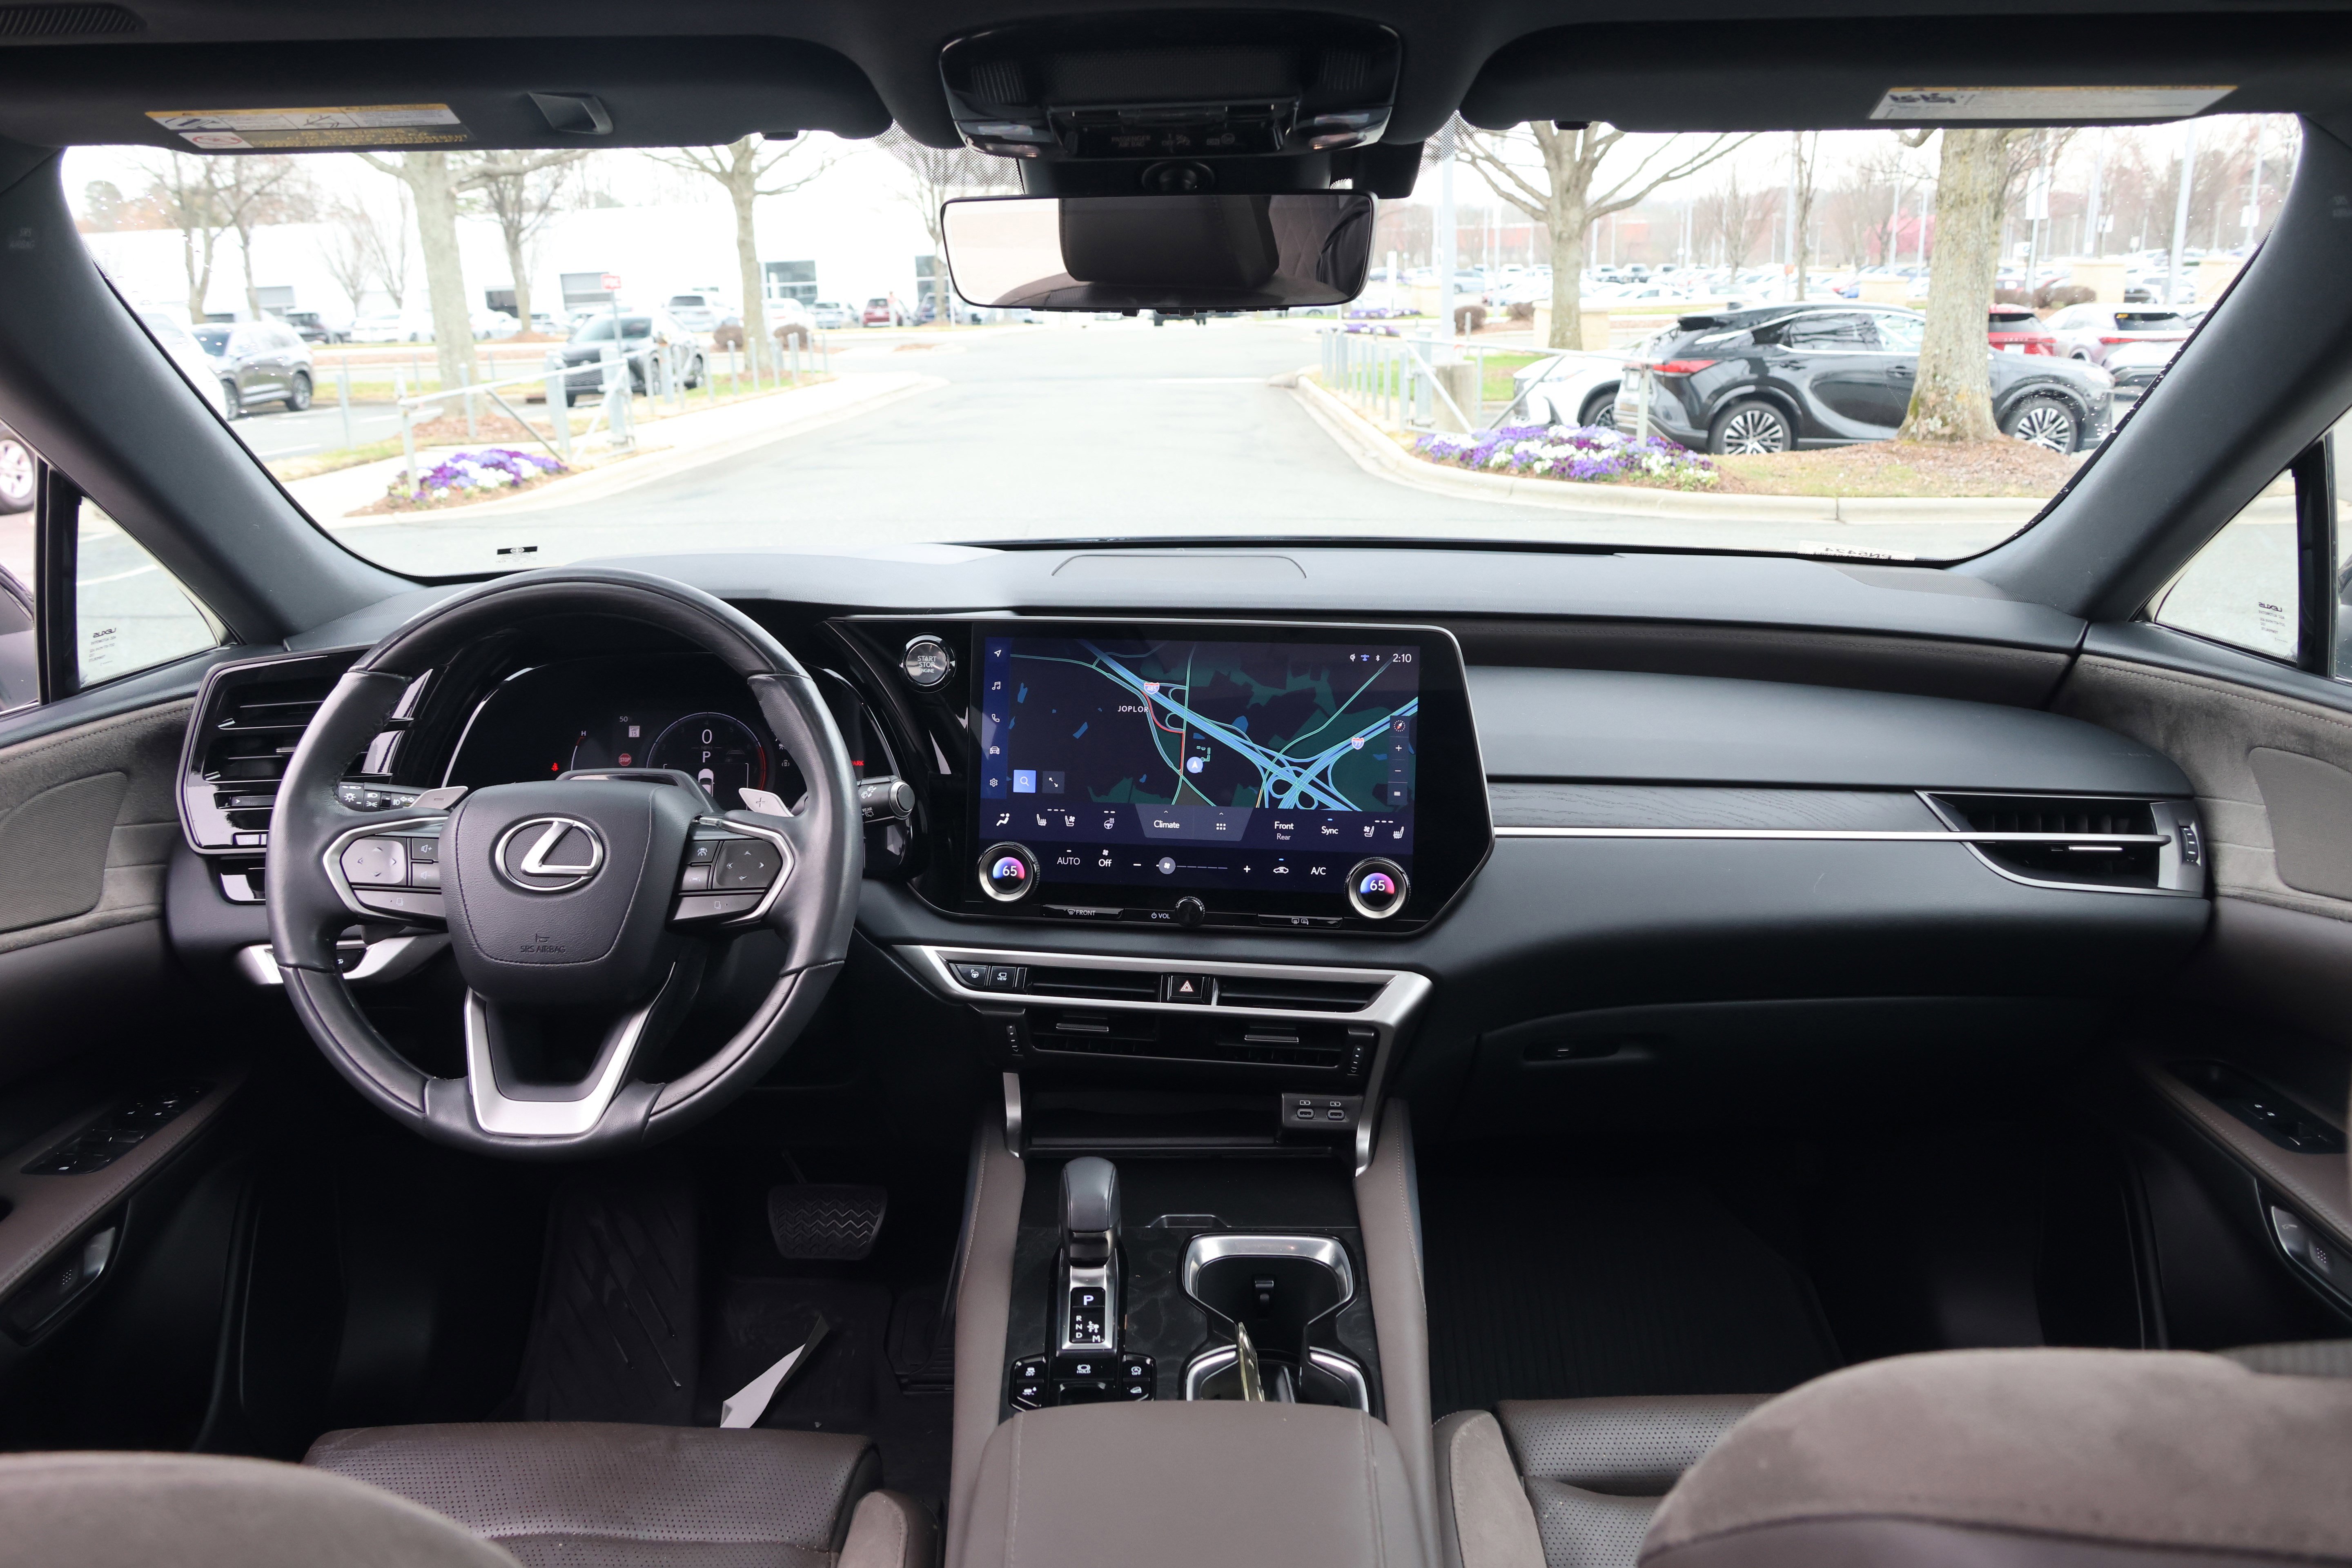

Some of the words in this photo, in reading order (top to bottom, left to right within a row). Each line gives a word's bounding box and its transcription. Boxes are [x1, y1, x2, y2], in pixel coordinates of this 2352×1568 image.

[1393, 654, 1412, 662] 2:10
[702, 729, 712, 744] 0
[702, 751, 711, 763] P
[1154, 820, 1180, 829] Climate
[1274, 822, 1294, 830] Front
[1321, 826, 1339, 835] Sync
[1057, 857, 1080, 865] AUTO
[1098, 859, 1112, 867] Off
[1002, 866, 1018, 877] 65
[1310, 866, 1326, 875] A/C
[1370, 880, 1385, 891] 65
[536, 945, 566, 953] AIRBAG
[1083, 1295, 1094, 1305] P
